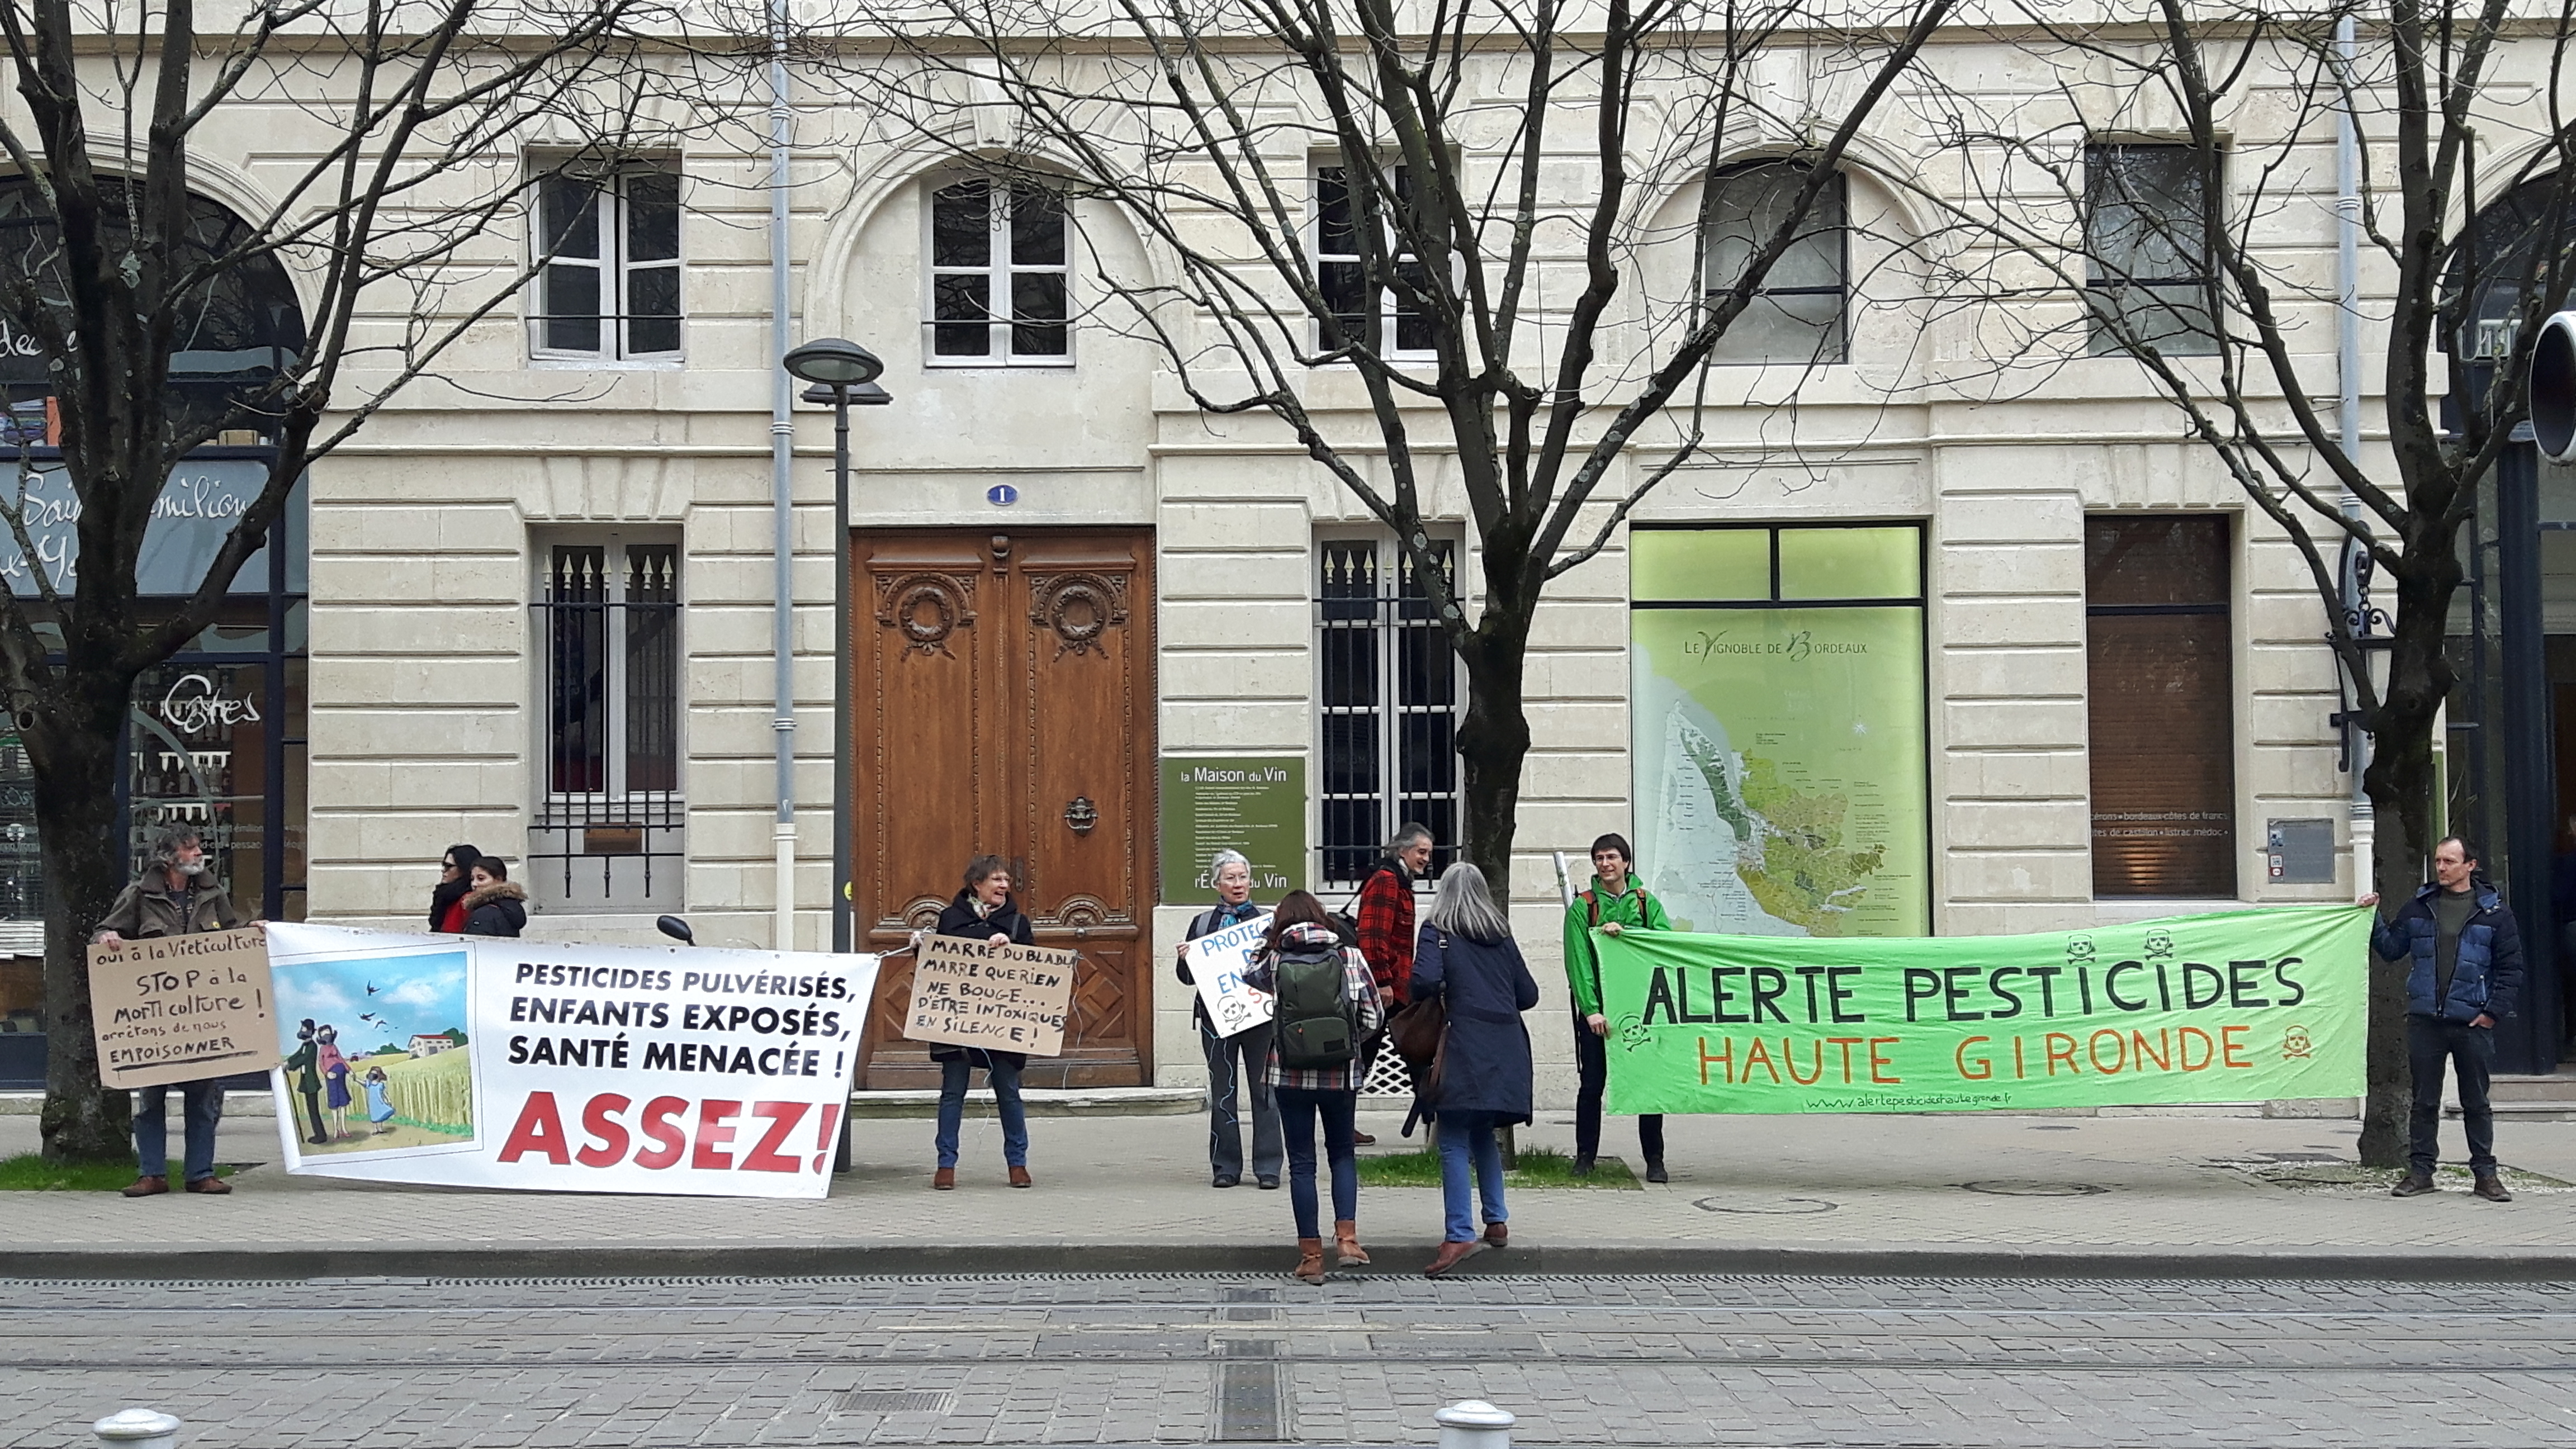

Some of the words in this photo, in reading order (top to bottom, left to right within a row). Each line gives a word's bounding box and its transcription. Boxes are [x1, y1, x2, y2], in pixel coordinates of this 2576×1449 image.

[999, 487, 1005, 502] 1
[1684, 641, 1699, 654] LE
[1768, 643, 1782, 654] DE
[1786, 631, 1868, 662] BORDEAUX
[1181, 771, 1190, 782] la
[1194, 766, 1244, 782] Maison
[1248, 771, 1261, 782] du
[1263, 766, 1286, 782] Vin
[1264, 873, 1287, 889] Vin
[1201, 916, 1273, 957] PROTECT
[149, 945, 164, 960] la
[931, 940, 996, 960] MARRE
[136, 970, 201, 996] STOP
[209, 969, 219, 985] à
[228, 967, 247, 984] la
[924, 959, 979, 978] MARRE
[985, 966, 1016, 981] QUE
[1217, 968, 1246, 995] EN
[515, 963, 672, 992] PESTICIDES
[681, 969, 856, 1003] PULVÉRISÉS,
[926, 981, 951, 996] NE
[1642, 966, 1865, 1025] ALERTE
[1904, 956, 2305, 1022] PESTICIDES
[173, 1022, 189, 1033] de
[509, 996, 670, 1029] ENFANTS
[682, 1002, 850, 1041] EXPOSÉS,
[916, 1015, 937, 1027] EN
[507, 1032, 629, 1069] SANTÉ
[642, 1041, 820, 1076] MENACÉE
[1697, 1036, 1901, 1086] HAUTE
[1955, 1025, 2253, 1081] GIRONDE
